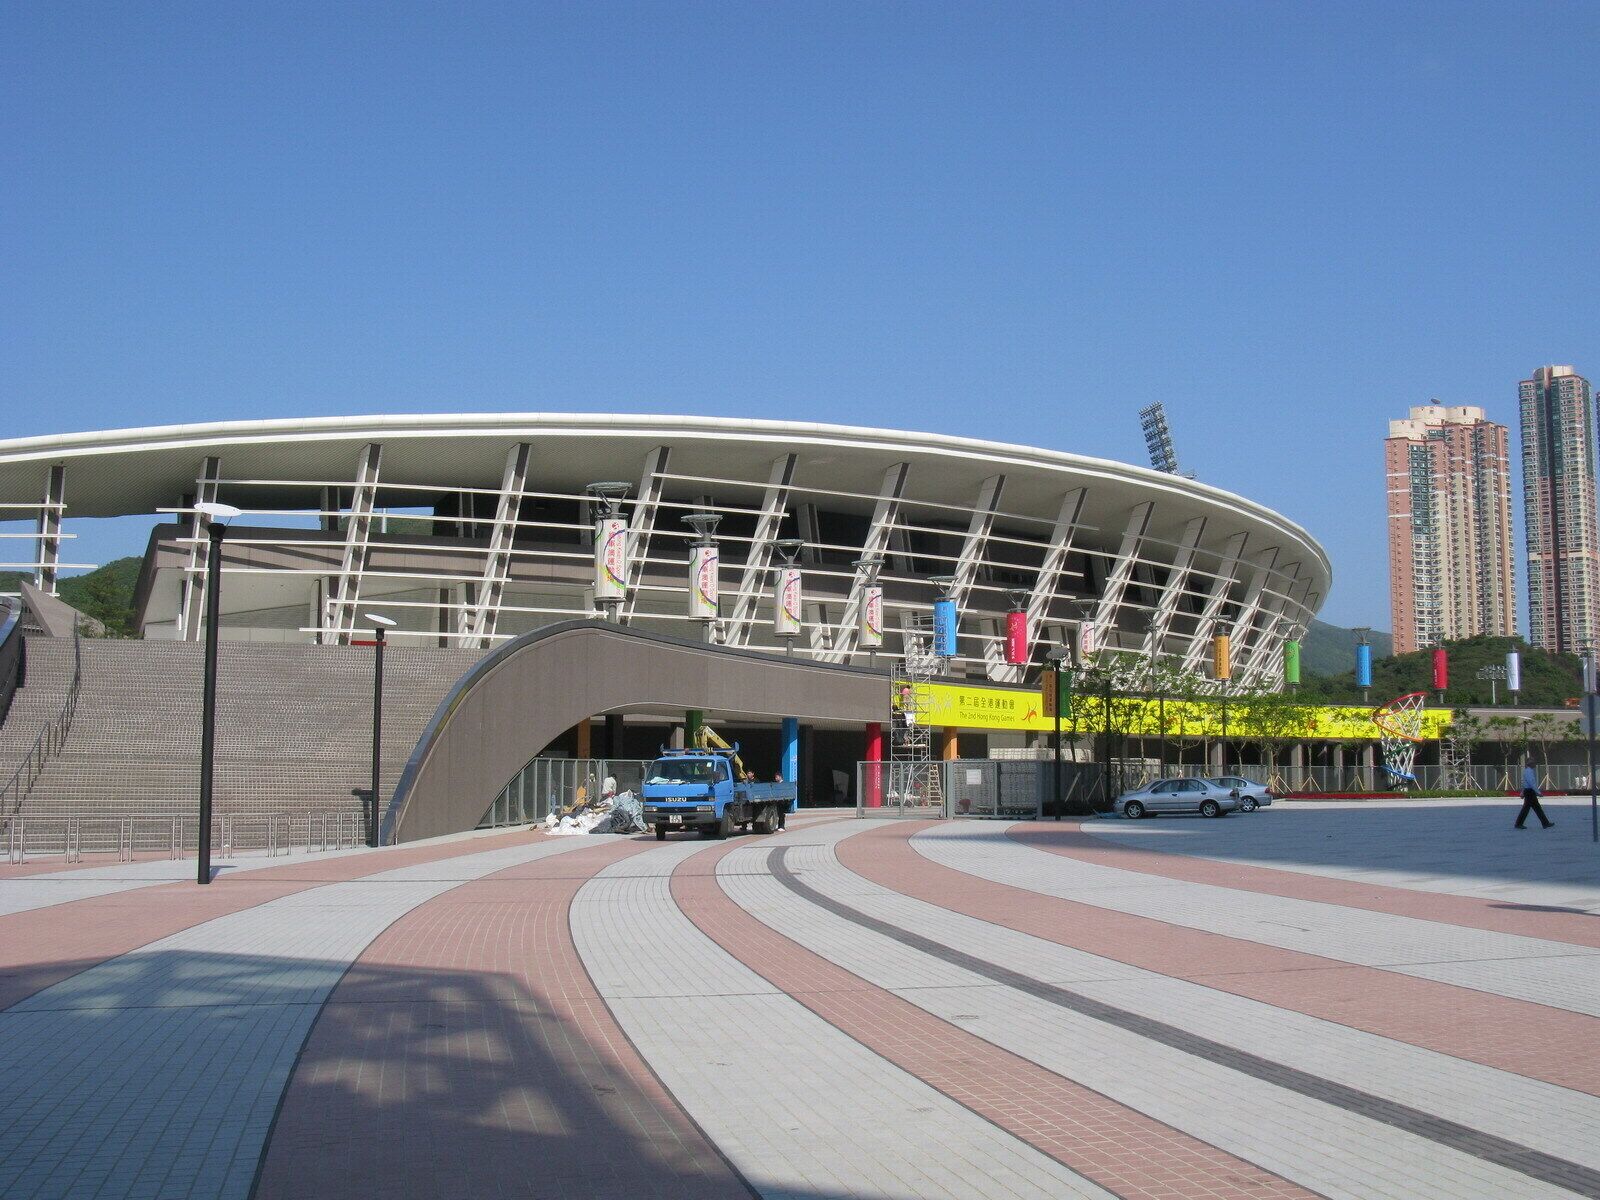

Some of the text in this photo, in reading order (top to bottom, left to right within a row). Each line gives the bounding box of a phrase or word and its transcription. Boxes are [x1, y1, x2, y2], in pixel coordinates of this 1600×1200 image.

[959, 711, 967, 719] The
[968, 712, 976, 720] 2nd
[977, 713, 988, 723] Hong
[989, 714, 1000, 723] Kong
